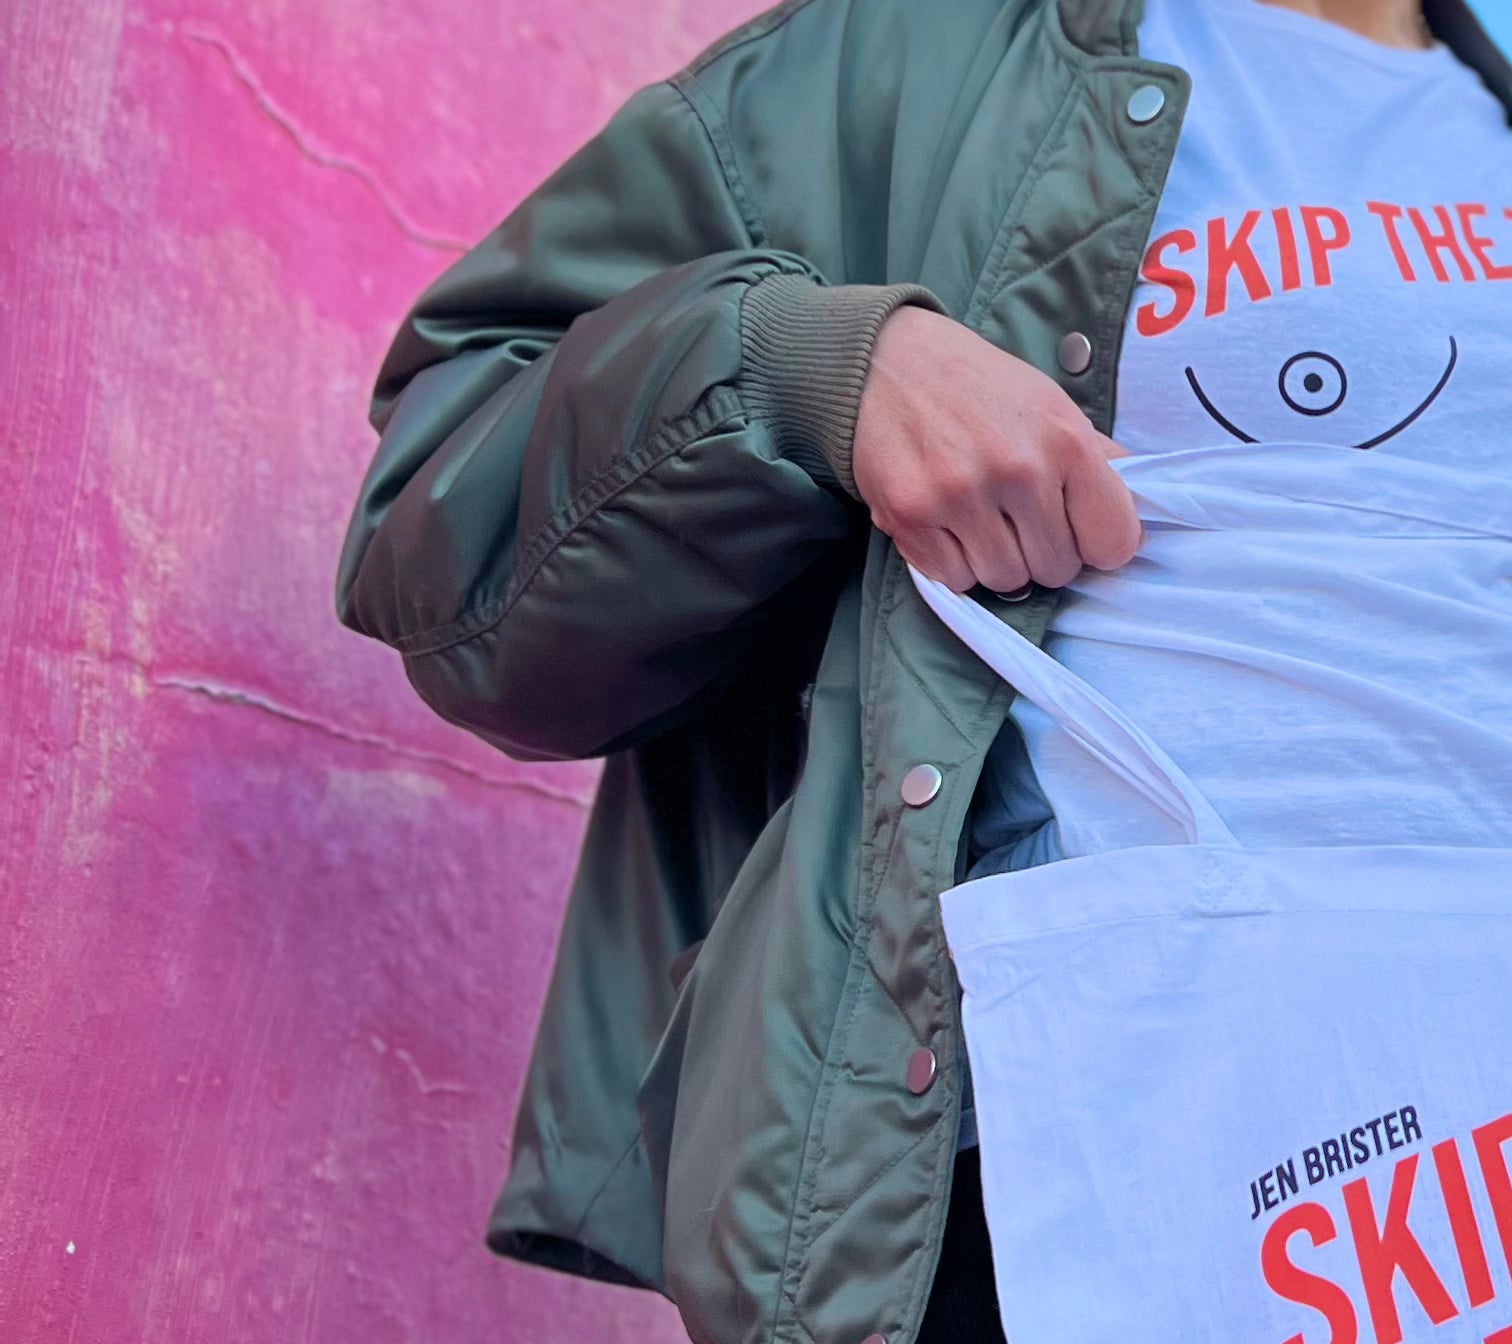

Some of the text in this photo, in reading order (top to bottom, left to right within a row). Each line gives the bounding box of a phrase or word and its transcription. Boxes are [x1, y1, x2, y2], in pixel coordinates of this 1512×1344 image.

[1135, 206, 1351, 338] SKIP
[1249, 1105, 1423, 1220] JEN BRISTER
